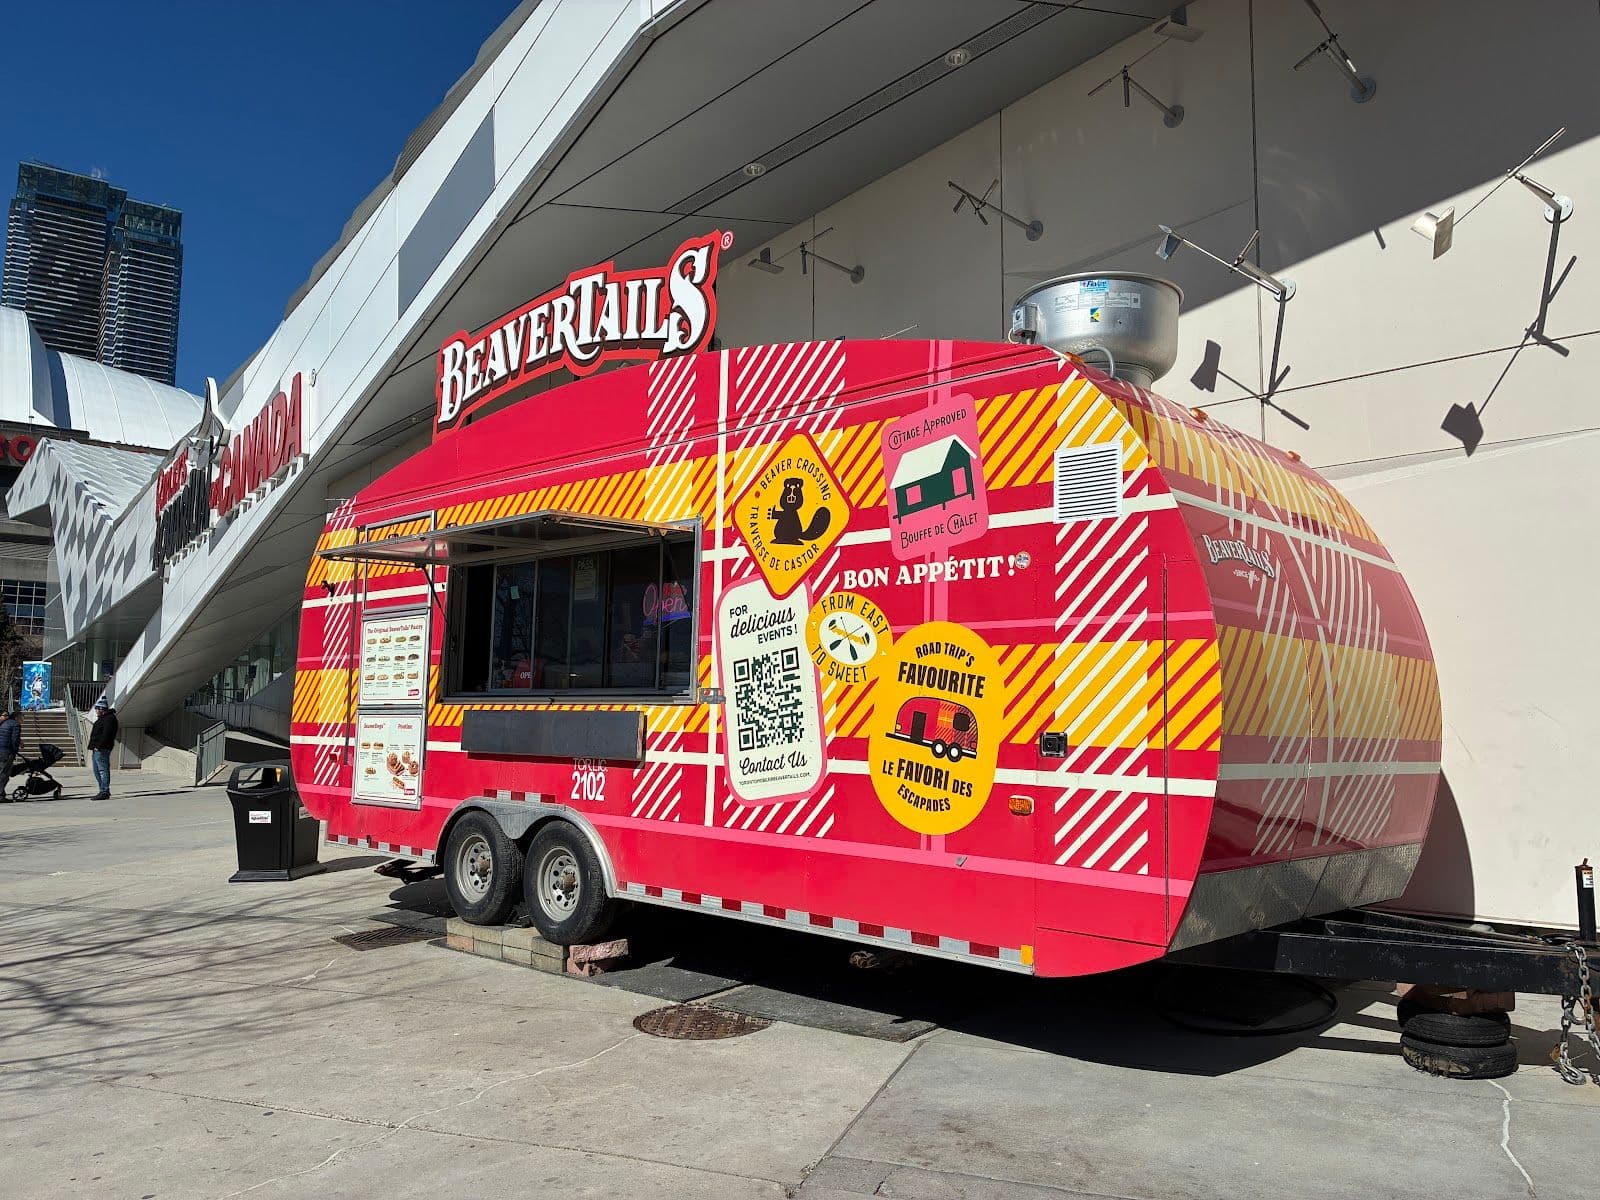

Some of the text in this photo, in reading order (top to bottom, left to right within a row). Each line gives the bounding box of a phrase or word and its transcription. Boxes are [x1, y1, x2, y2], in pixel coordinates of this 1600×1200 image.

[438, 245, 710, 424] BEAVERTAILS
[217, 372, 302, 518] CANADA
[888, 408, 967, 451] COTTAGE APPROVED
[760, 457, 831, 501] BEAVER CROSSING
[750, 505, 820, 571] TRAVERSE DE CASTOR
[900, 513, 978, 549] BOUFFE DE CHALET
[843, 567, 890, 590] BON
[729, 604, 748, 619] FOR
[730, 606, 796, 639] delicious
[821, 594, 889, 635] FROM EAST
[811, 643, 868, 684] TO SWEET
[915, 641, 975, 668] ROAD TRIP'S
[897, 661, 986, 699] FAVOURITE
[739, 750, 807, 776] Contact Us
[882, 758, 973, 798] LE FAVORI DES
[571, 770, 606, 801] 2102
[897, 783, 951, 812] ESCAPADES
